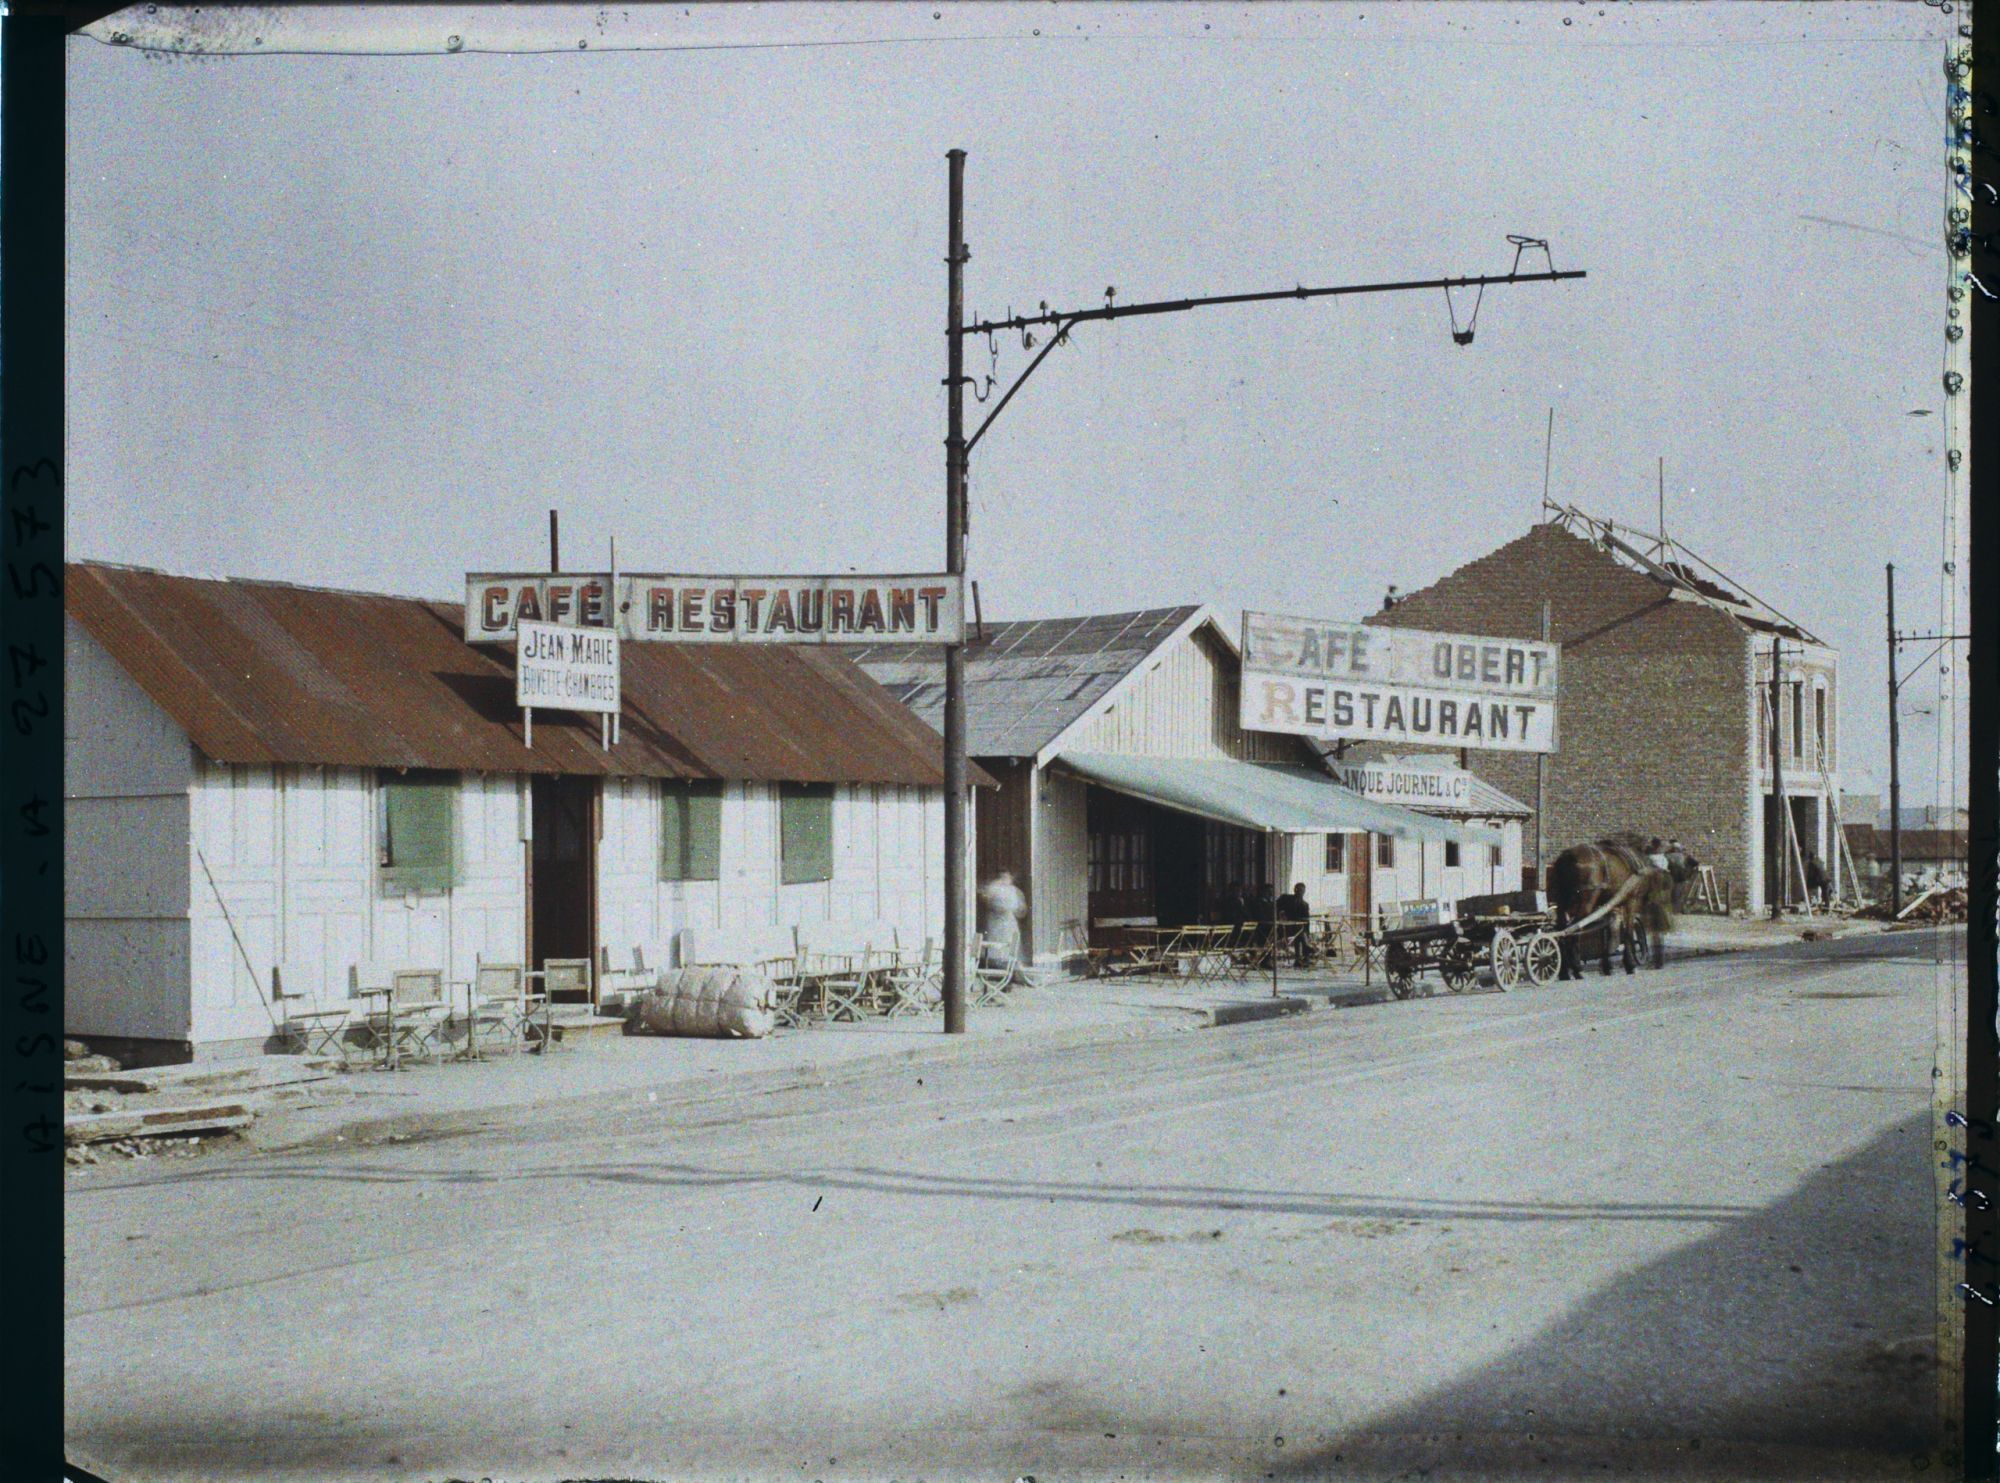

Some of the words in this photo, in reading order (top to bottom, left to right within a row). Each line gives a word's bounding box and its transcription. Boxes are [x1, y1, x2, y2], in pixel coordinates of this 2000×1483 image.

[6, 457, 60, 600] 573
[646, 586, 948, 635] RESTAURANT
[1399, 636, 1549, 687] OBERT
[1260, 680, 1536, 742] RESTAURANT
[1343, 769, 1384, 796] ANQUE
